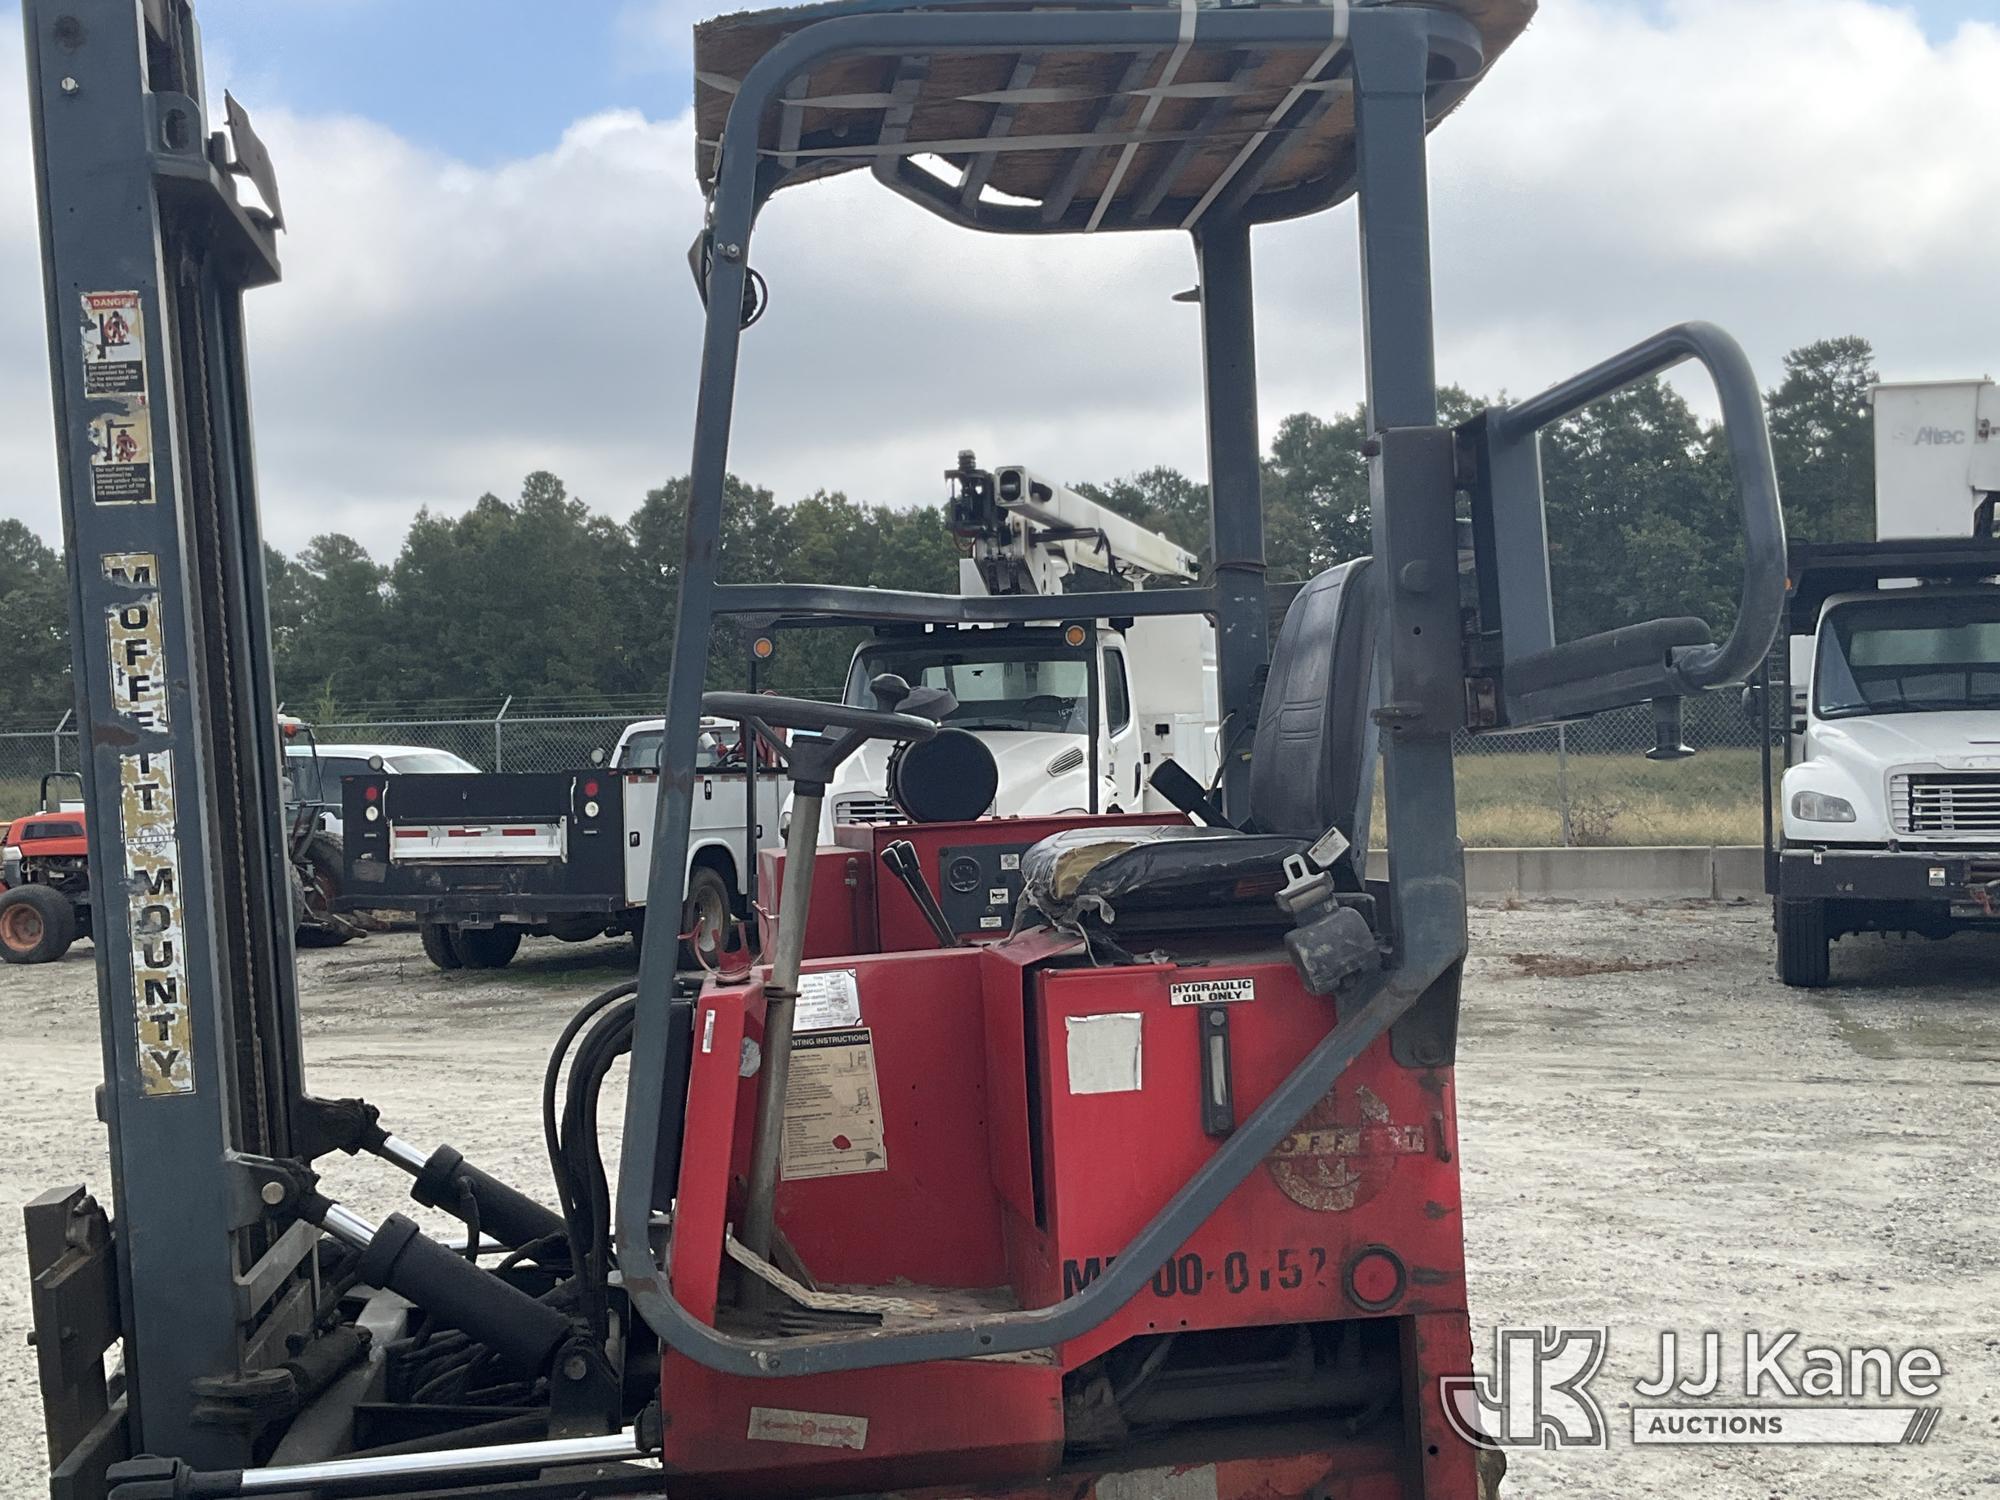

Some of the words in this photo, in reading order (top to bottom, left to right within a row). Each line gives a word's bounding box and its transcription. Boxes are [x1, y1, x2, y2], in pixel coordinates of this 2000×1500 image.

[1914, 427, 1965, 445] Altec
[134, 868, 179, 1077] MOUNTY
[1172, 980, 1252, 994] HYDRAULIC
[1182, 993, 1204, 1003] OIL
[1208, 991, 1242, 1001] ONLY
[816, 1034, 869, 1045] INSTRUCTIONS
